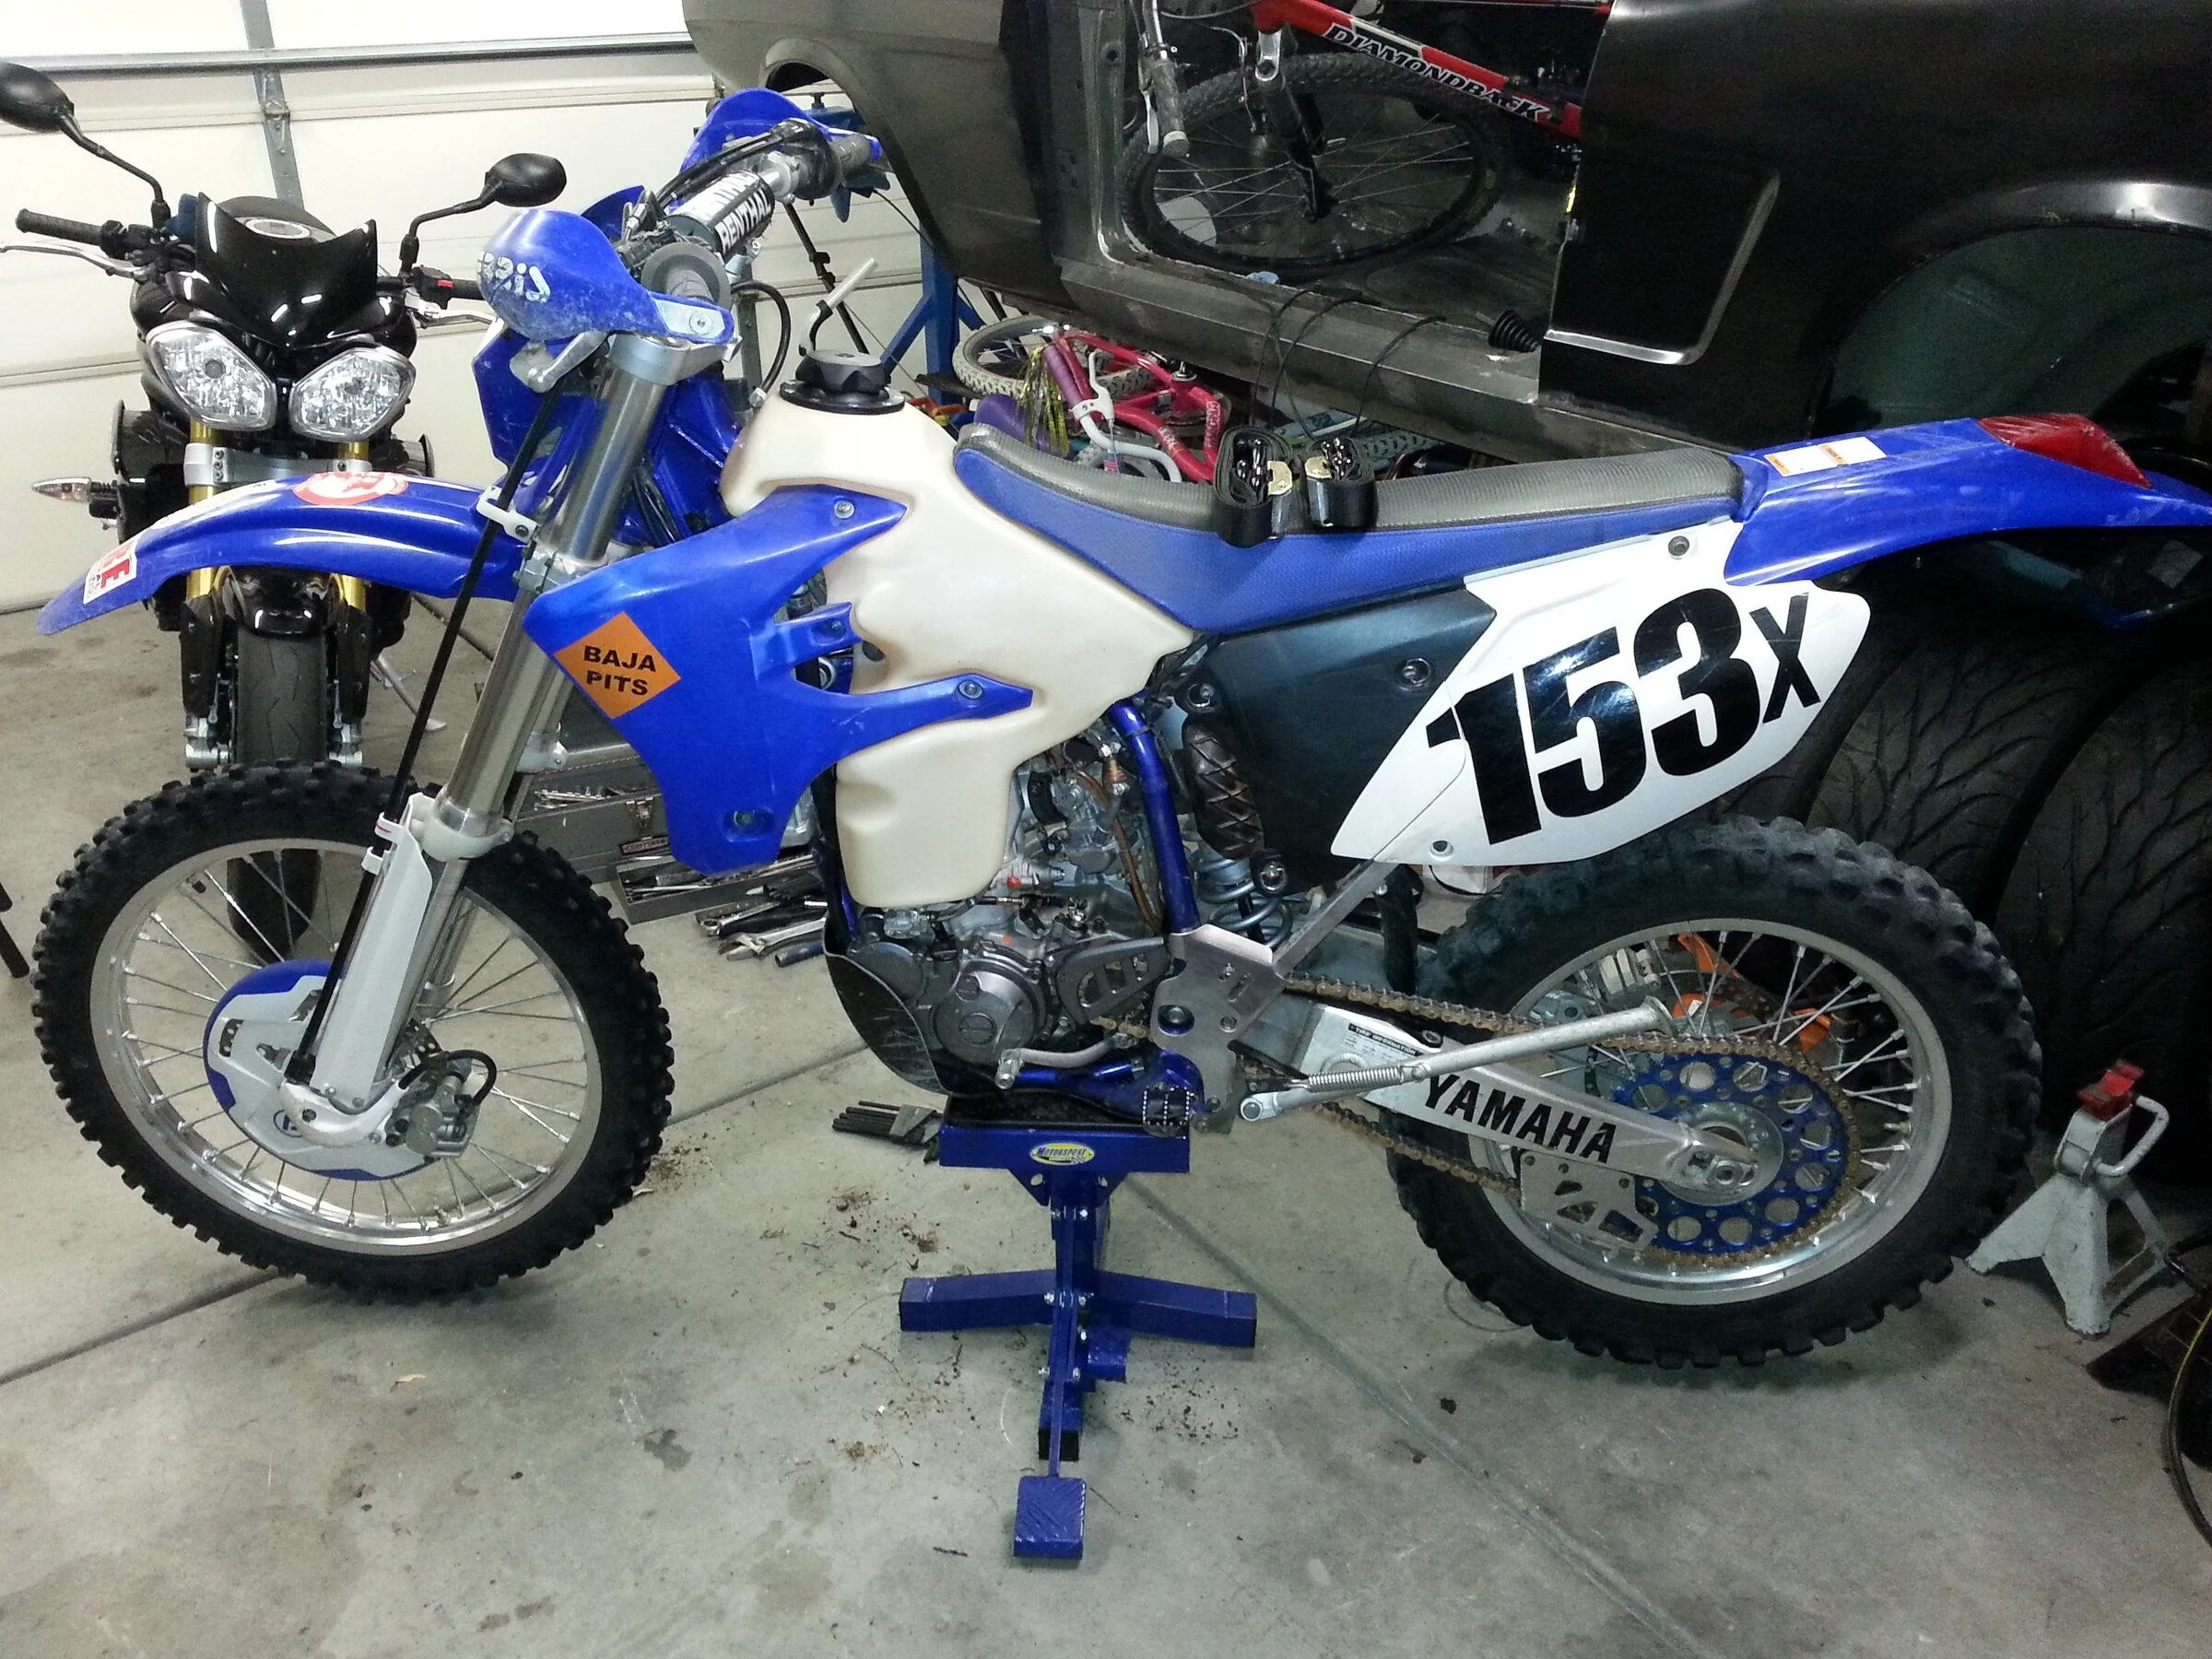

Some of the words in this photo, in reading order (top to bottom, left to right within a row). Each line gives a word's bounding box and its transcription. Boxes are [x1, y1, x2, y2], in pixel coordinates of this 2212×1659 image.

[1323, 22, 1550, 123] DIAMONDBACK
[714, 188, 772, 256] RENTHAL
[583, 645, 656, 673] BAJA
[586, 670, 648, 696] PITS
[1425, 1073, 1617, 1164] YAMAHA
